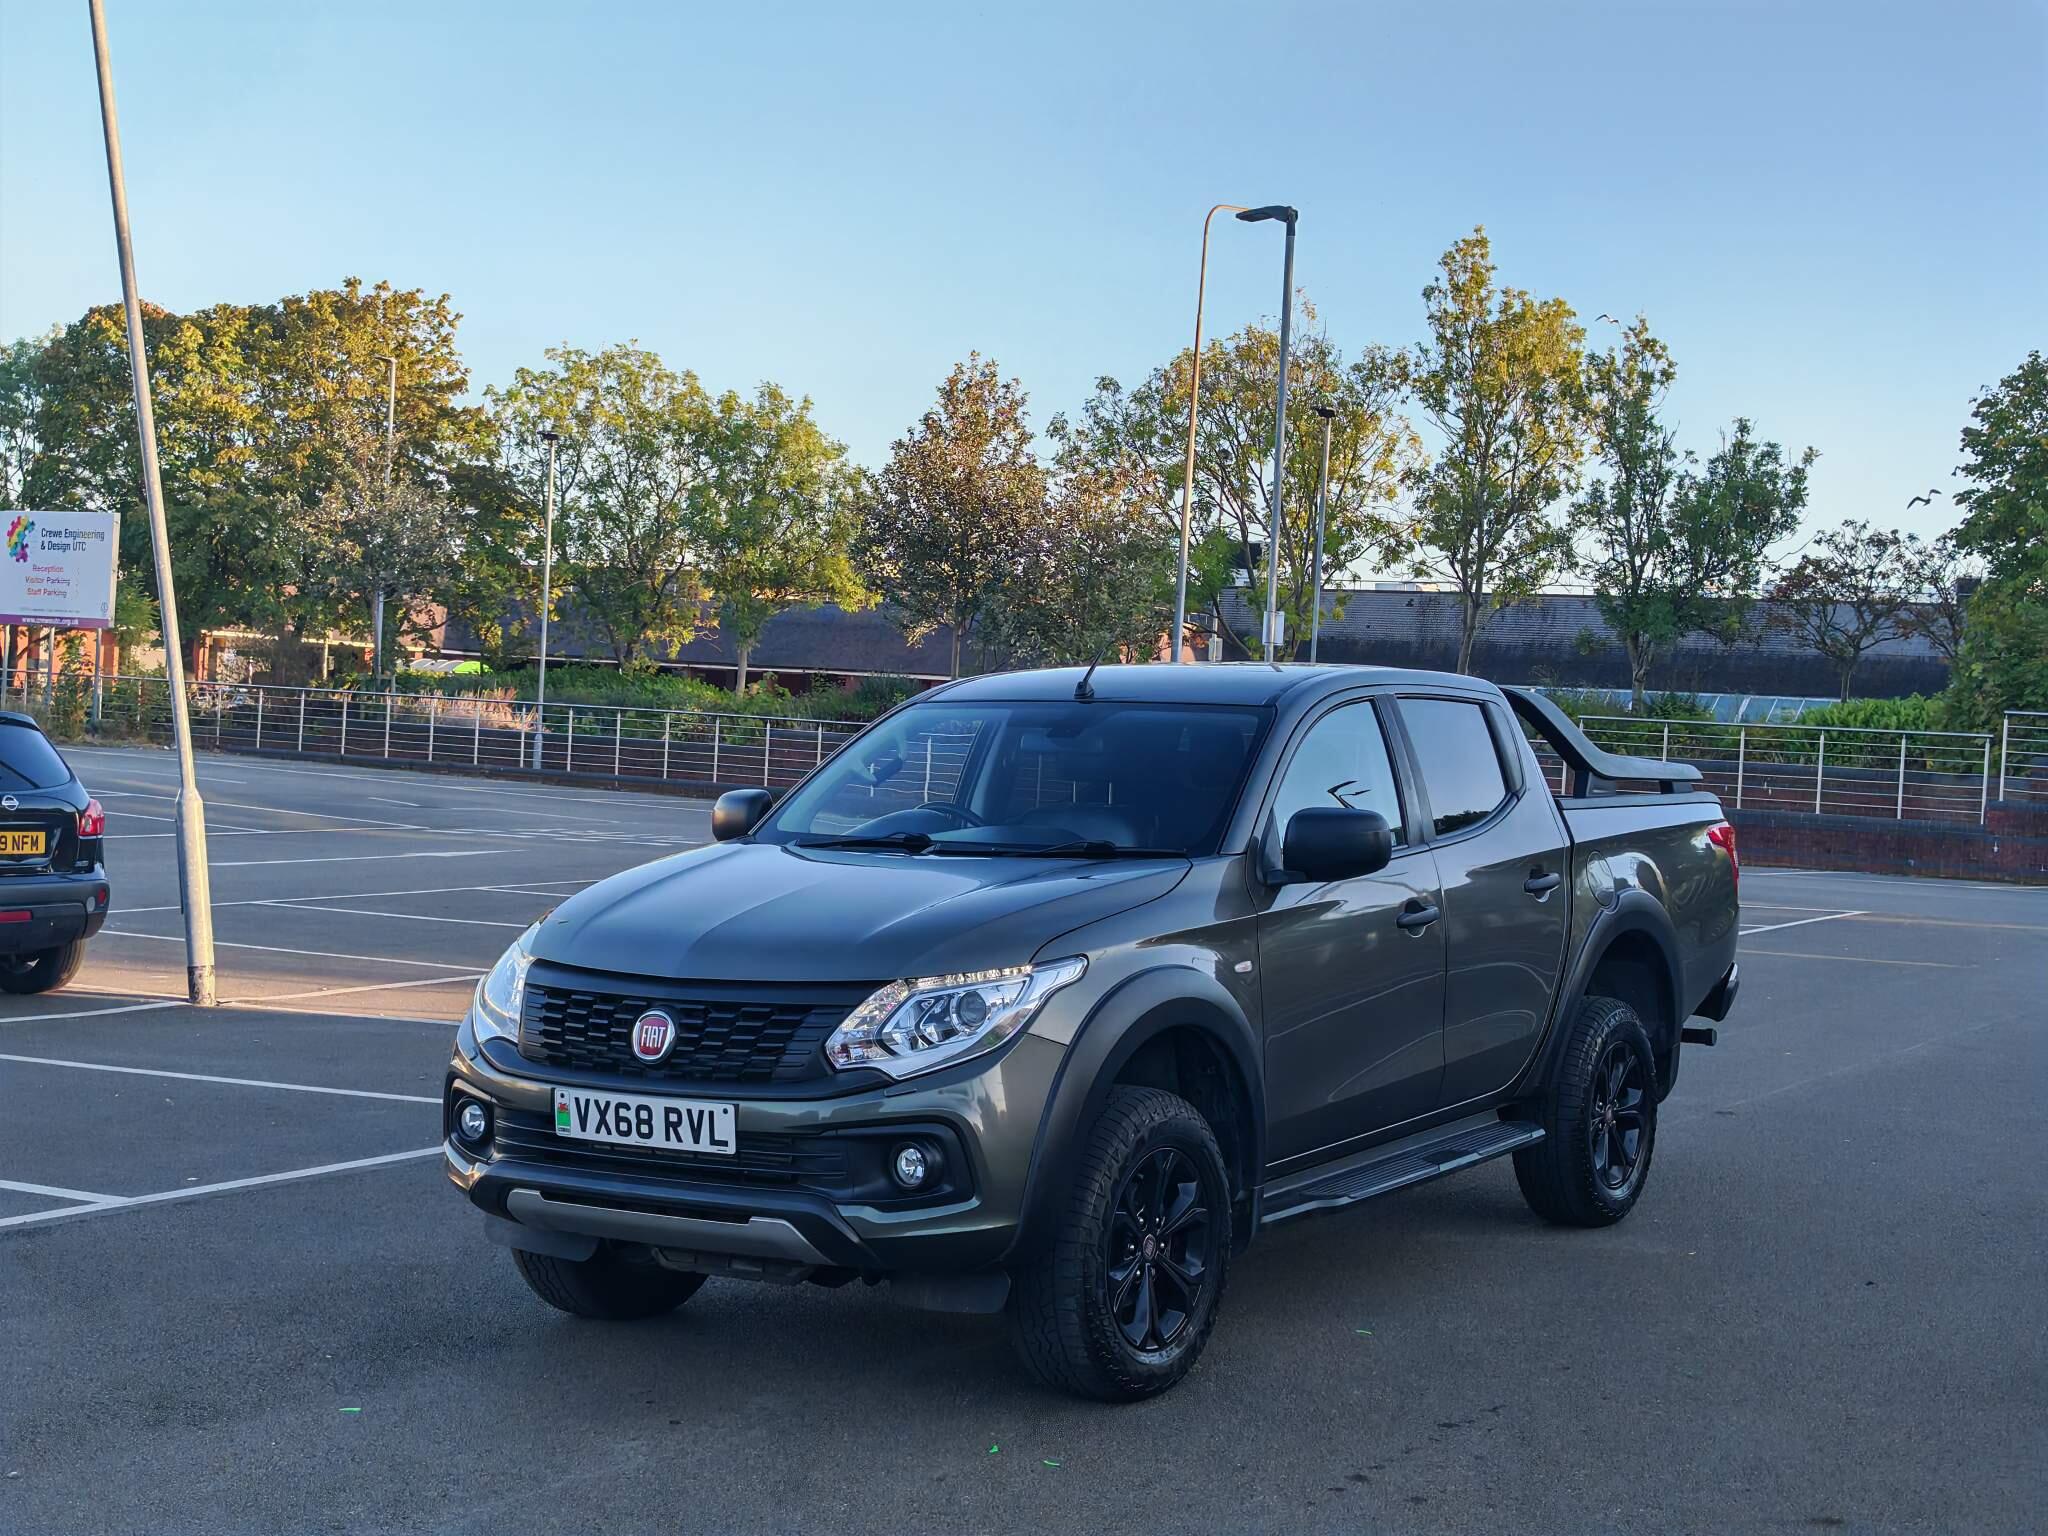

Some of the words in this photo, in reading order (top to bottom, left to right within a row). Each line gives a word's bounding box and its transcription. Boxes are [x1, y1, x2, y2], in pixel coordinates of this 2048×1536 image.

[41, 528, 62, 538] Crewe
[64, 528, 105, 541] Engineering
[40, 541, 46, 551] &
[47, 540, 71, 552] Design
[72, 541, 87, 552] UTC
[46, 576, 71, 586] Parking
[43, 588, 68, 598] Parking
[12, 834, 39, 851] NFM
[641, 1025, 666, 1048] FIAT
[574, 1096, 654, 1139] VX68
[664, 1106, 729, 1147] RVL
